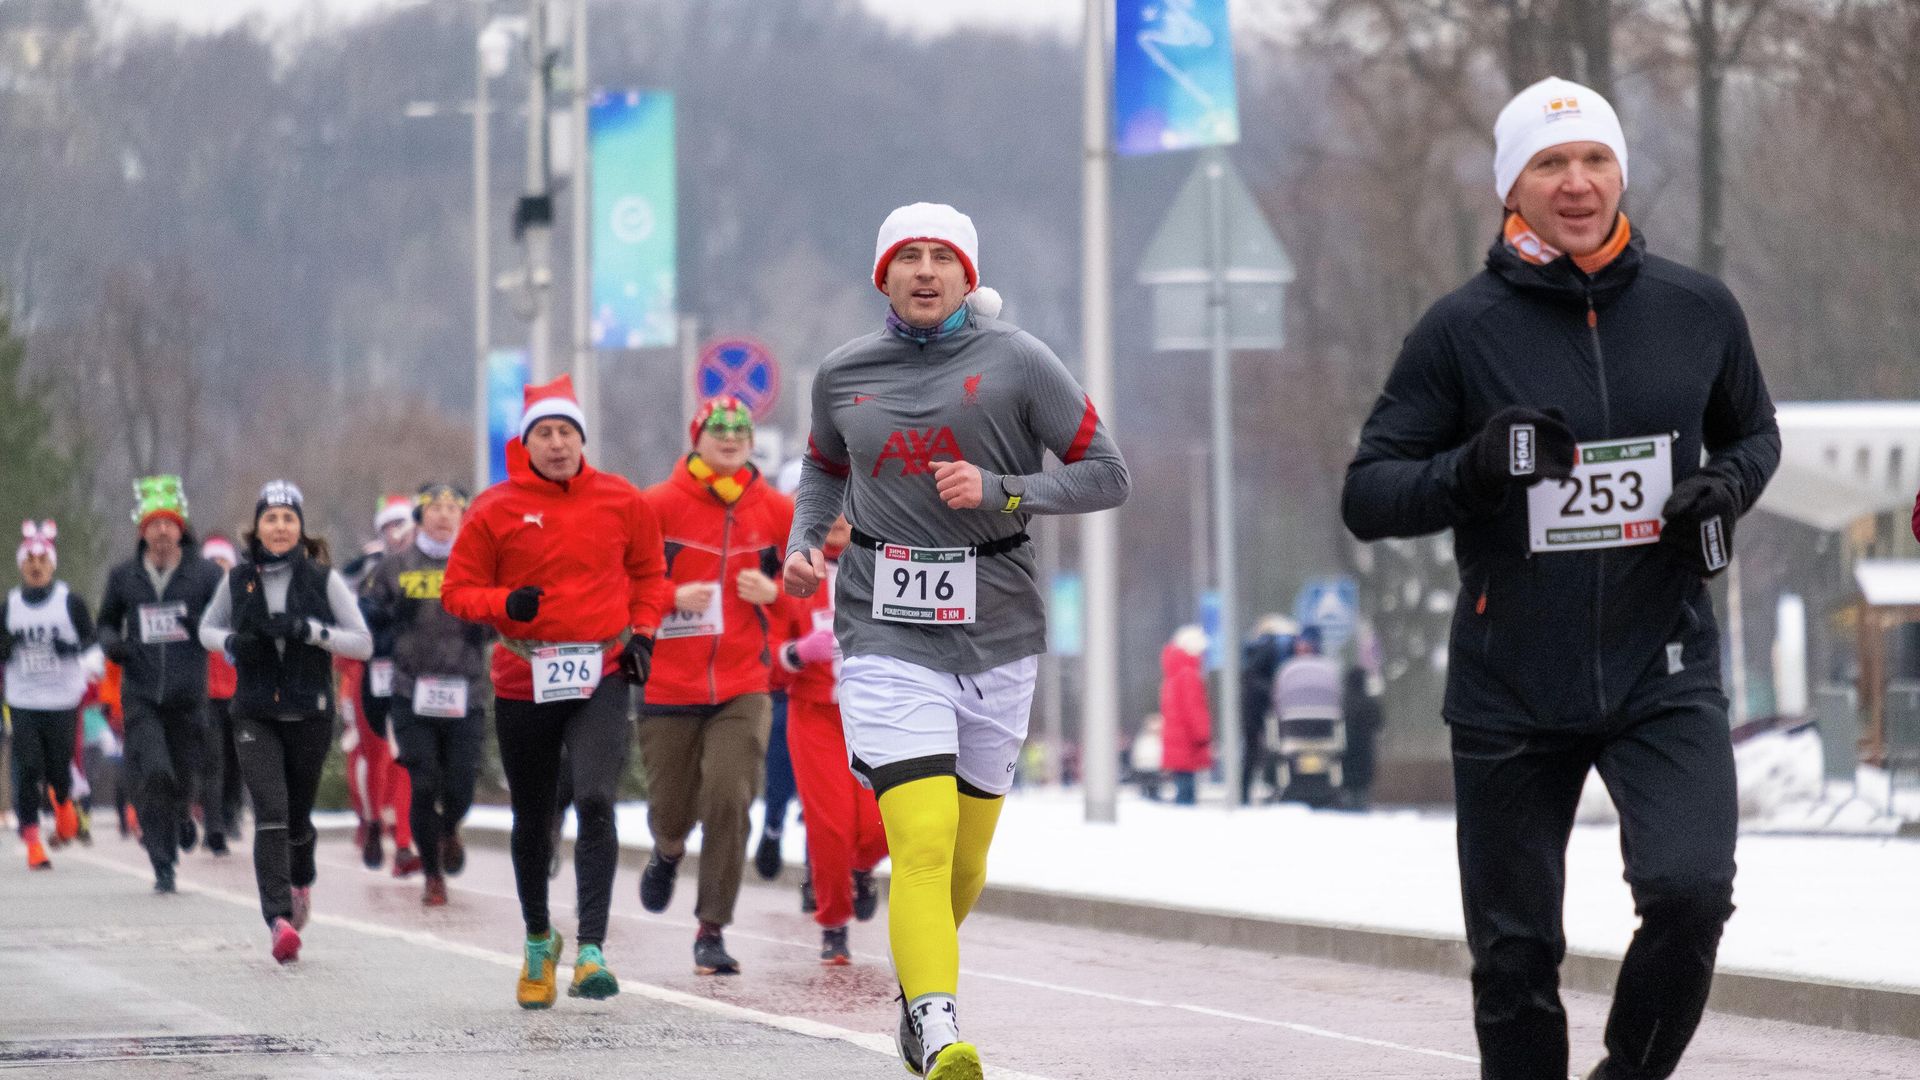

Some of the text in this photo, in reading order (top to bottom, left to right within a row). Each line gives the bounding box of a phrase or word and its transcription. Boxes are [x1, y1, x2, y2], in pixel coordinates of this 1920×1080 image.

[871, 426, 964, 478] AXA
[1559, 471, 1644, 517] 253
[893, 568, 954, 600] 916
[942, 610, 948, 619] 5
[547, 660, 590, 684] 296
